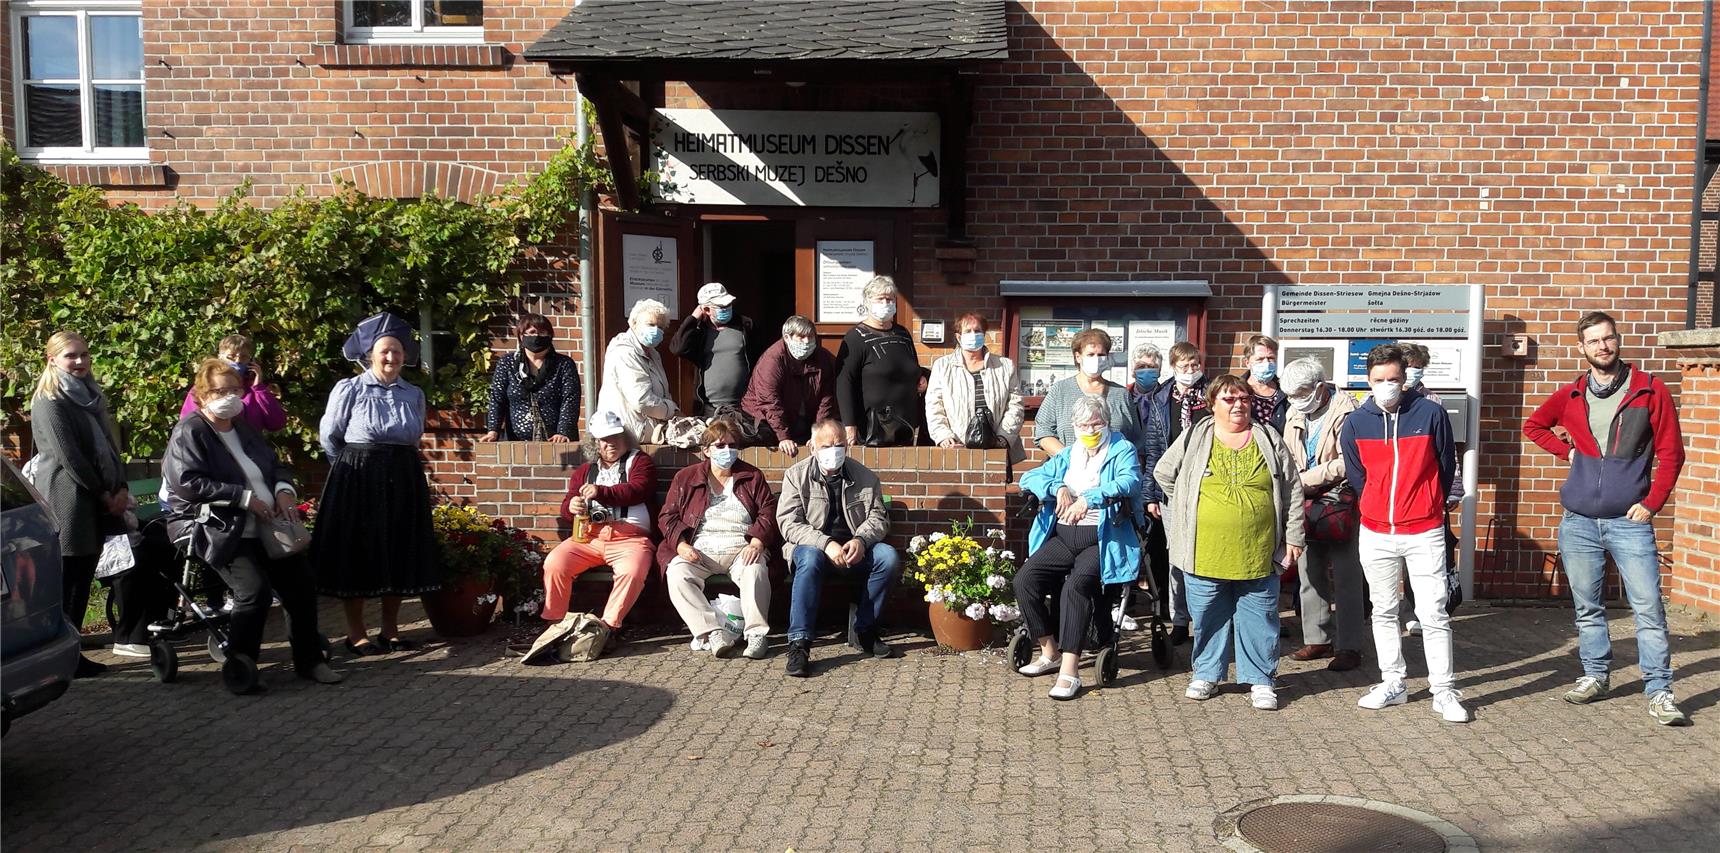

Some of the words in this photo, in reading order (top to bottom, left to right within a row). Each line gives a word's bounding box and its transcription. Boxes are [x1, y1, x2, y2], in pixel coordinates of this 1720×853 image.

[674, 132, 817, 155] HEIMATMUSEUM
[824, 134, 890, 156] DISSEN
[689, 164, 750, 182] SERBSKI
[755, 165, 806, 187] MUZEJ
[814, 160, 868, 184] DEŠNO
[1367, 290, 1391, 298] Gmejna
